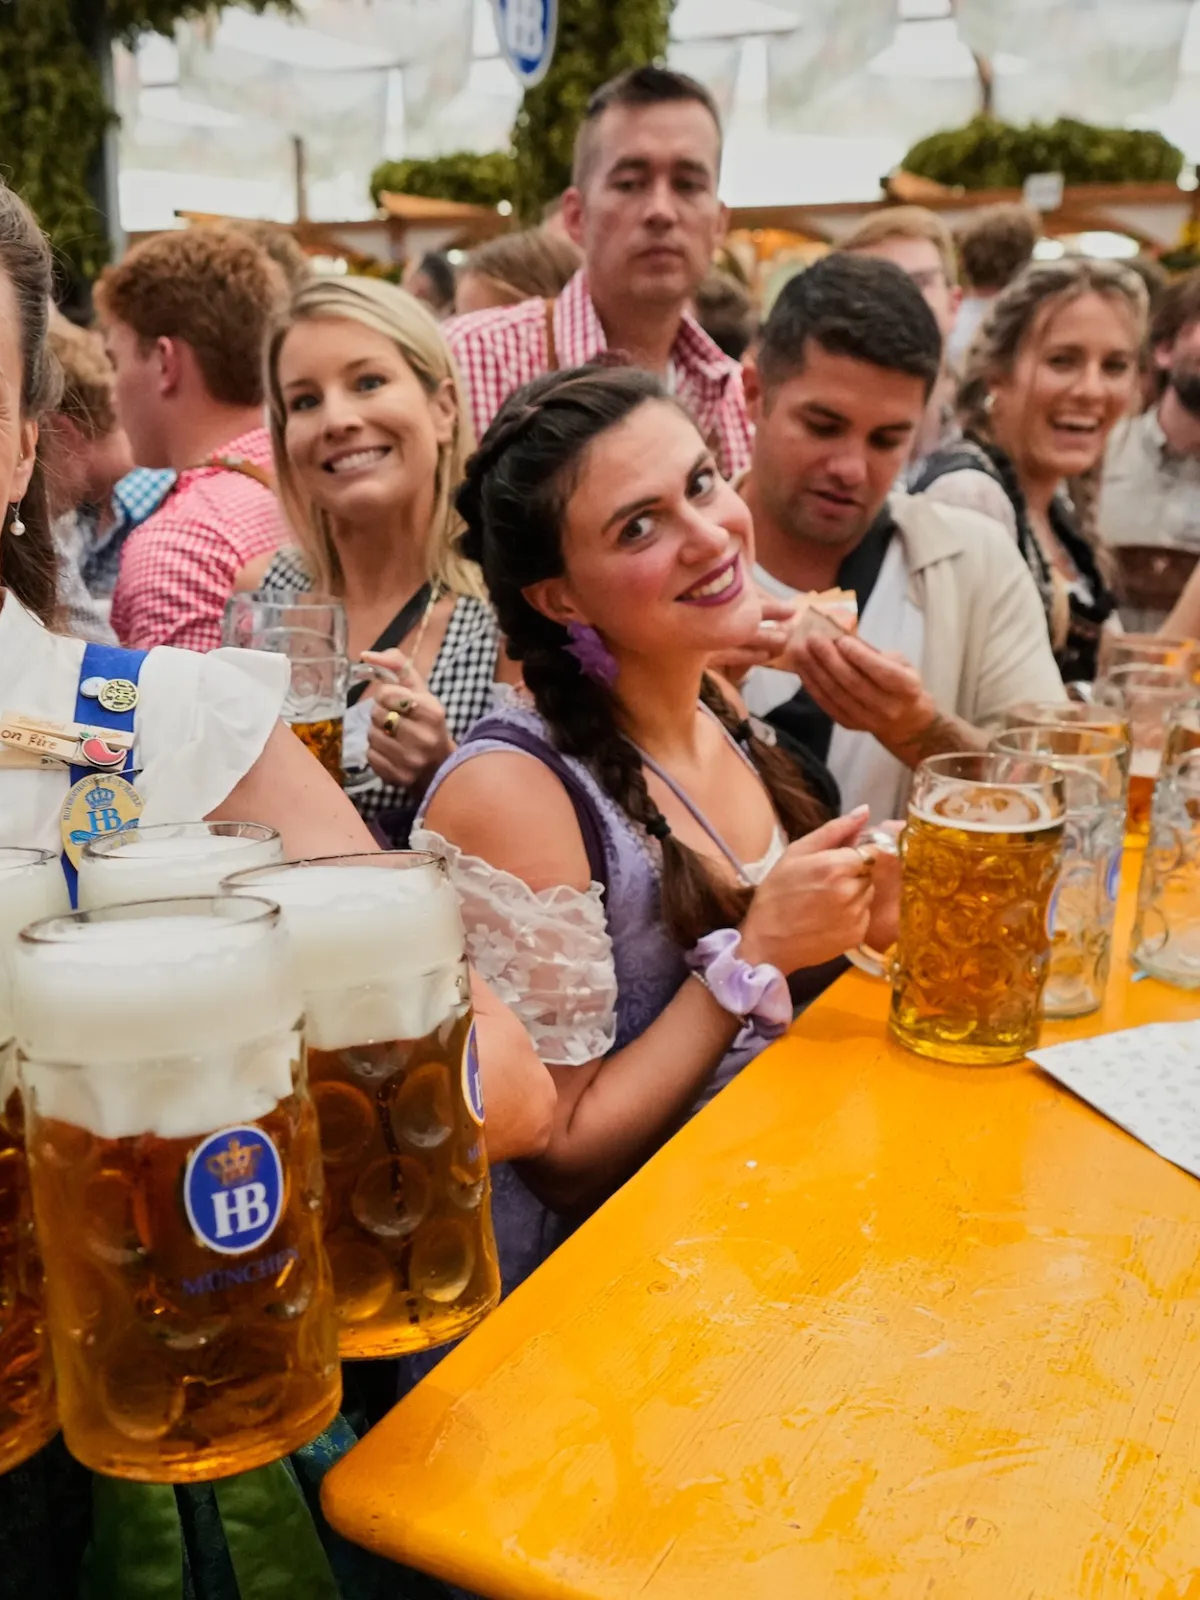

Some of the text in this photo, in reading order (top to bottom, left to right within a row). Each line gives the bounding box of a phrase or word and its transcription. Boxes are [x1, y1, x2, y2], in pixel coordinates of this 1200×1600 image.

[0, 729, 58, 750] on fire
[86, 808, 122, 833] HB
[211, 1182, 270, 1239] HB
